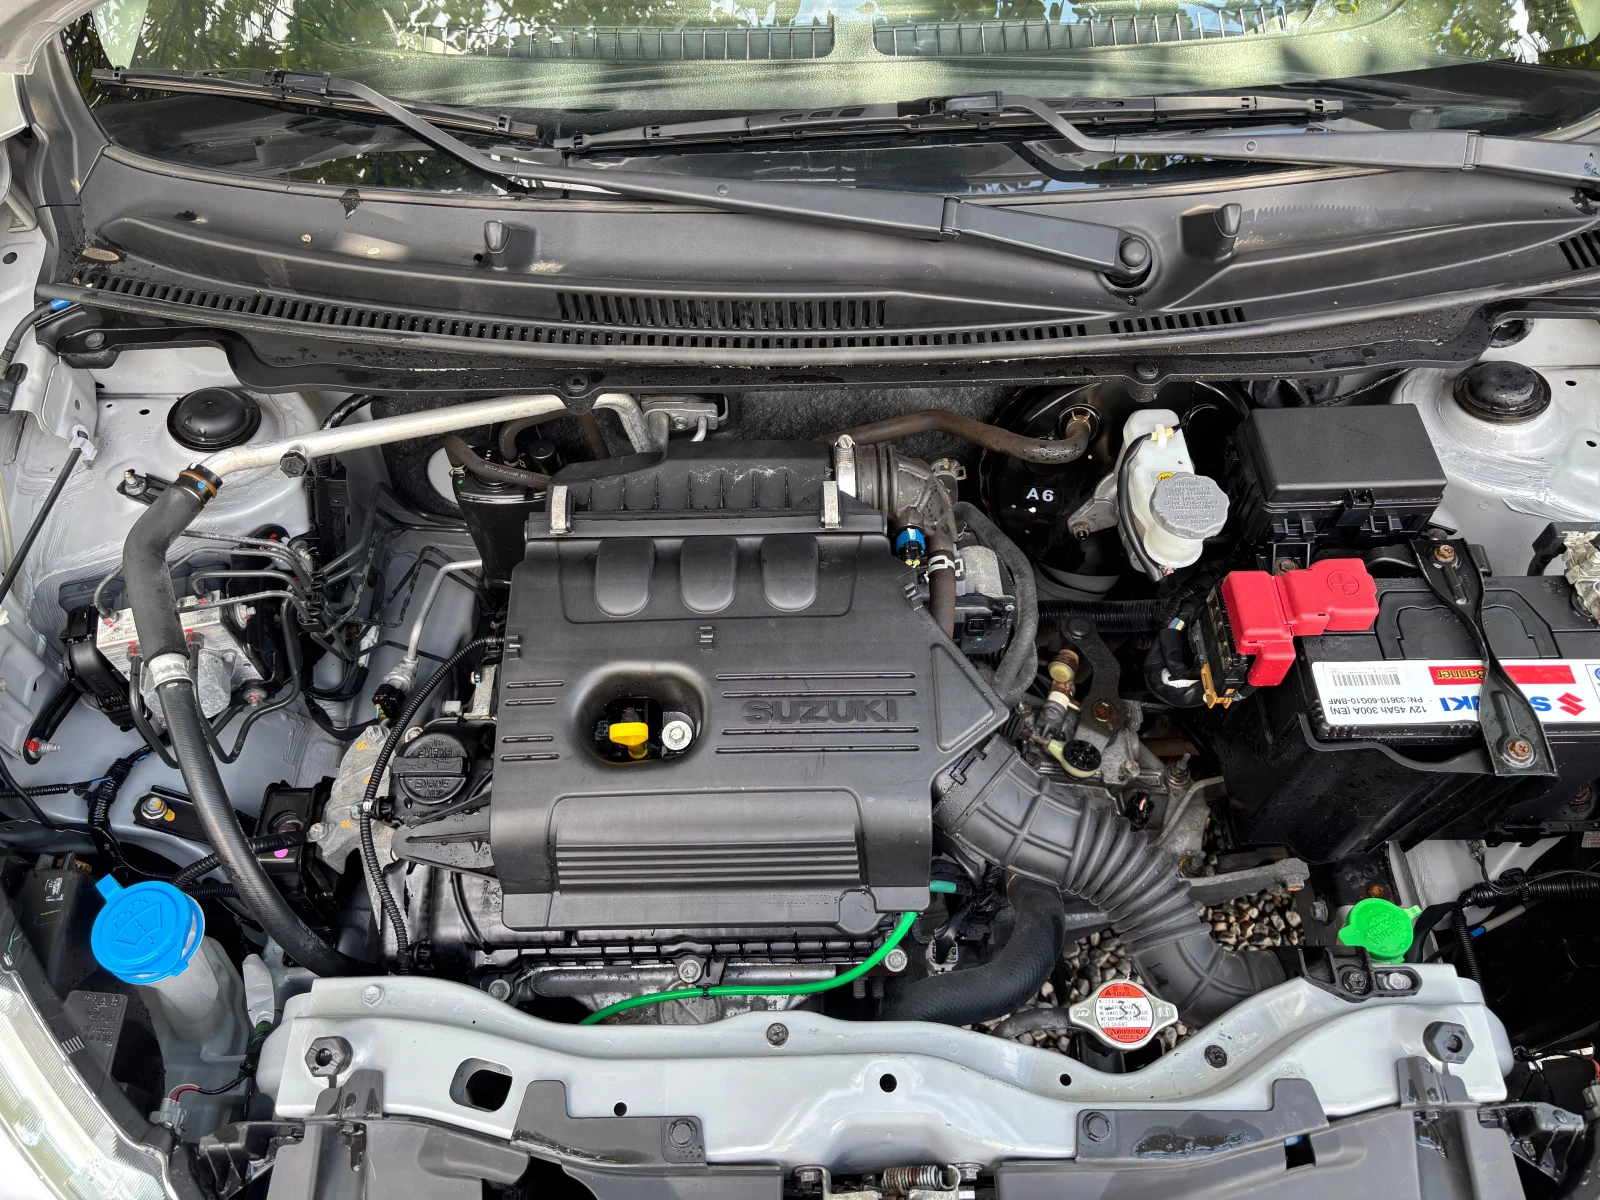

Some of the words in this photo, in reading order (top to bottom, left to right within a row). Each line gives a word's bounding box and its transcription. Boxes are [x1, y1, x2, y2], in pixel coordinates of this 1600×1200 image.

[1025, 487, 1055, 502] A6
[1436, 668, 1485, 681] Banner
[1328, 696, 1406, 705] 33610-60G10-BMF
[1439, 695, 1552, 712] SKI
[743, 699, 899, 724] SUZUKI
[1329, 705, 1351, 715] (EN)
[1352, 706, 1378, 715] 300A
[1380, 705, 1406, 714] 45Ah
[1409, 705, 1428, 714] 12V
[1368, 912, 1390, 926] ONLY
[1364, 915, 1402, 938] COOLANT
[1371, 923, 1406, 945] ENGINE
